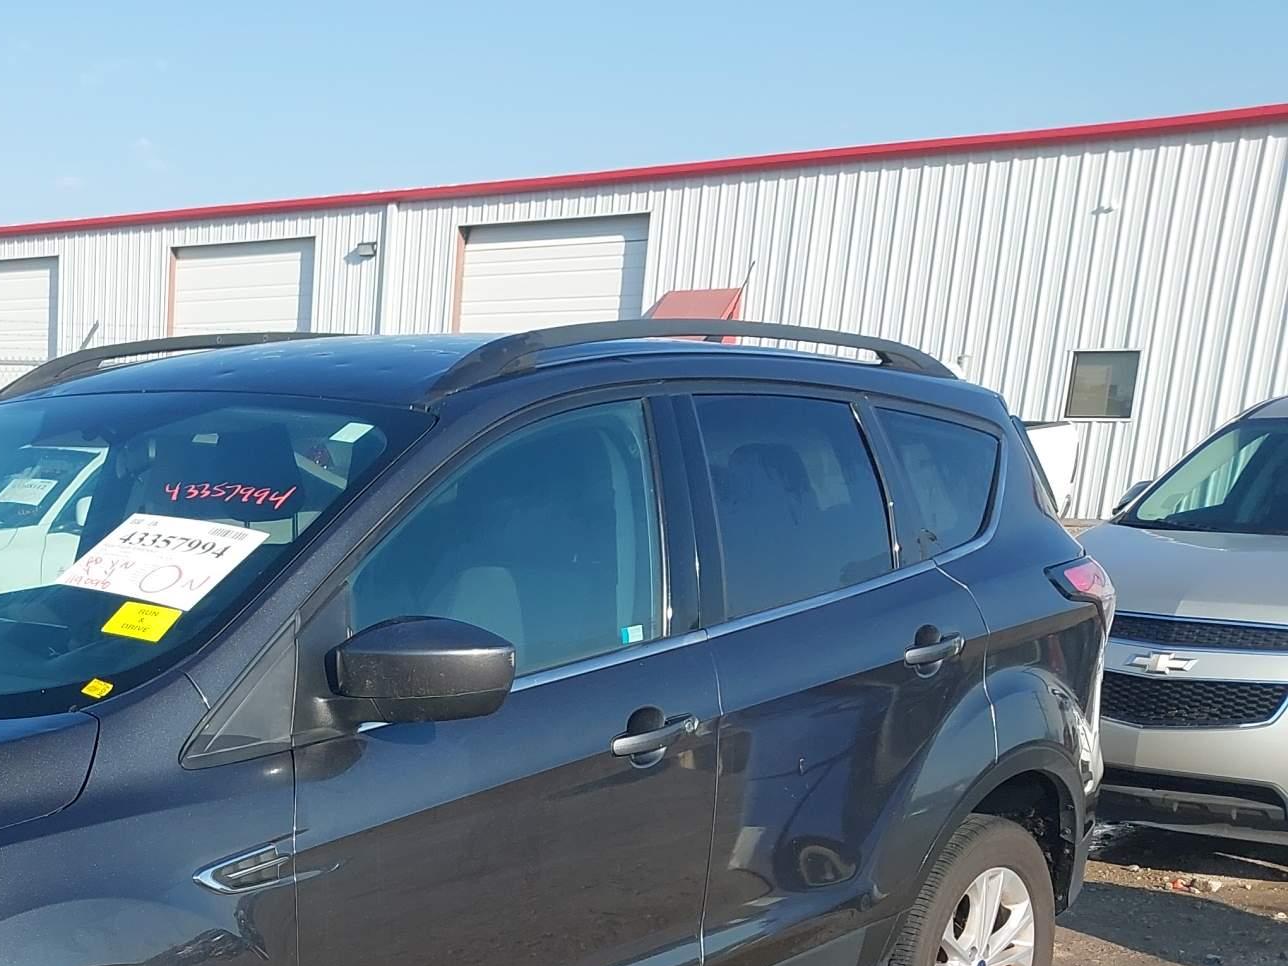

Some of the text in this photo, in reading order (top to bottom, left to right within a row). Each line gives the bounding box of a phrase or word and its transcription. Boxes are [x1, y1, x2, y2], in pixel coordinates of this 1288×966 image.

[165, 481, 297, 510] 43357994
[119, 530, 233, 559] 43357994
[138, 608, 160, 617] RUN
[120, 623, 150, 633] DRIVE
